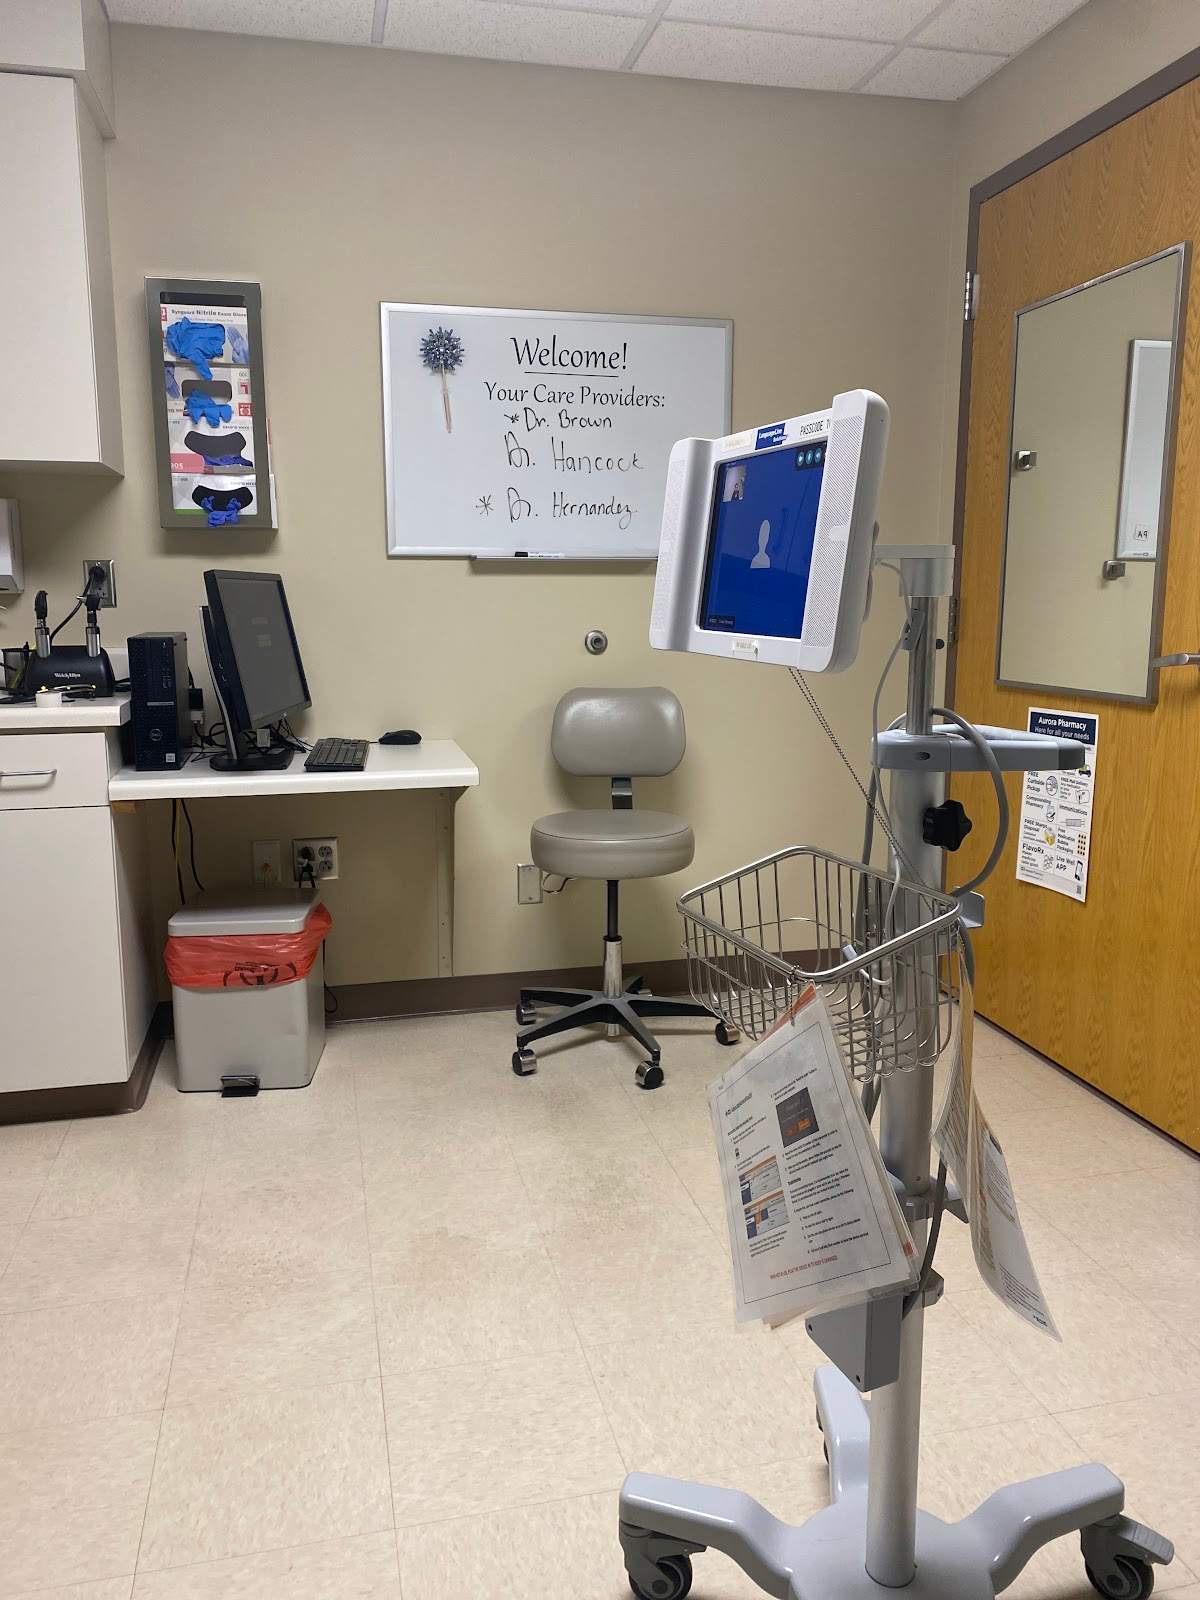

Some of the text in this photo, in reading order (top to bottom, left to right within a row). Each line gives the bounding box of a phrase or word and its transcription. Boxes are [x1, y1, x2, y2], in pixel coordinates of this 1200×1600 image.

[509, 334, 628, 370] Welcome!
[484, 381, 666, 408] Your Care Providers:
[523, 407, 612, 432] Dr. Brown
[799, 420, 824, 436] PASSCODE
[503, 431, 644, 474] Dr. Hancock
[507, 487, 638, 530] Dr. Hernandez
[1034, 726, 1046, 734] Here
[1046, 727, 1054, 735] for
[1038, 716, 1087, 731] Aurora Pharmacy
[1022, 842, 1044, 854] FlavoRx
